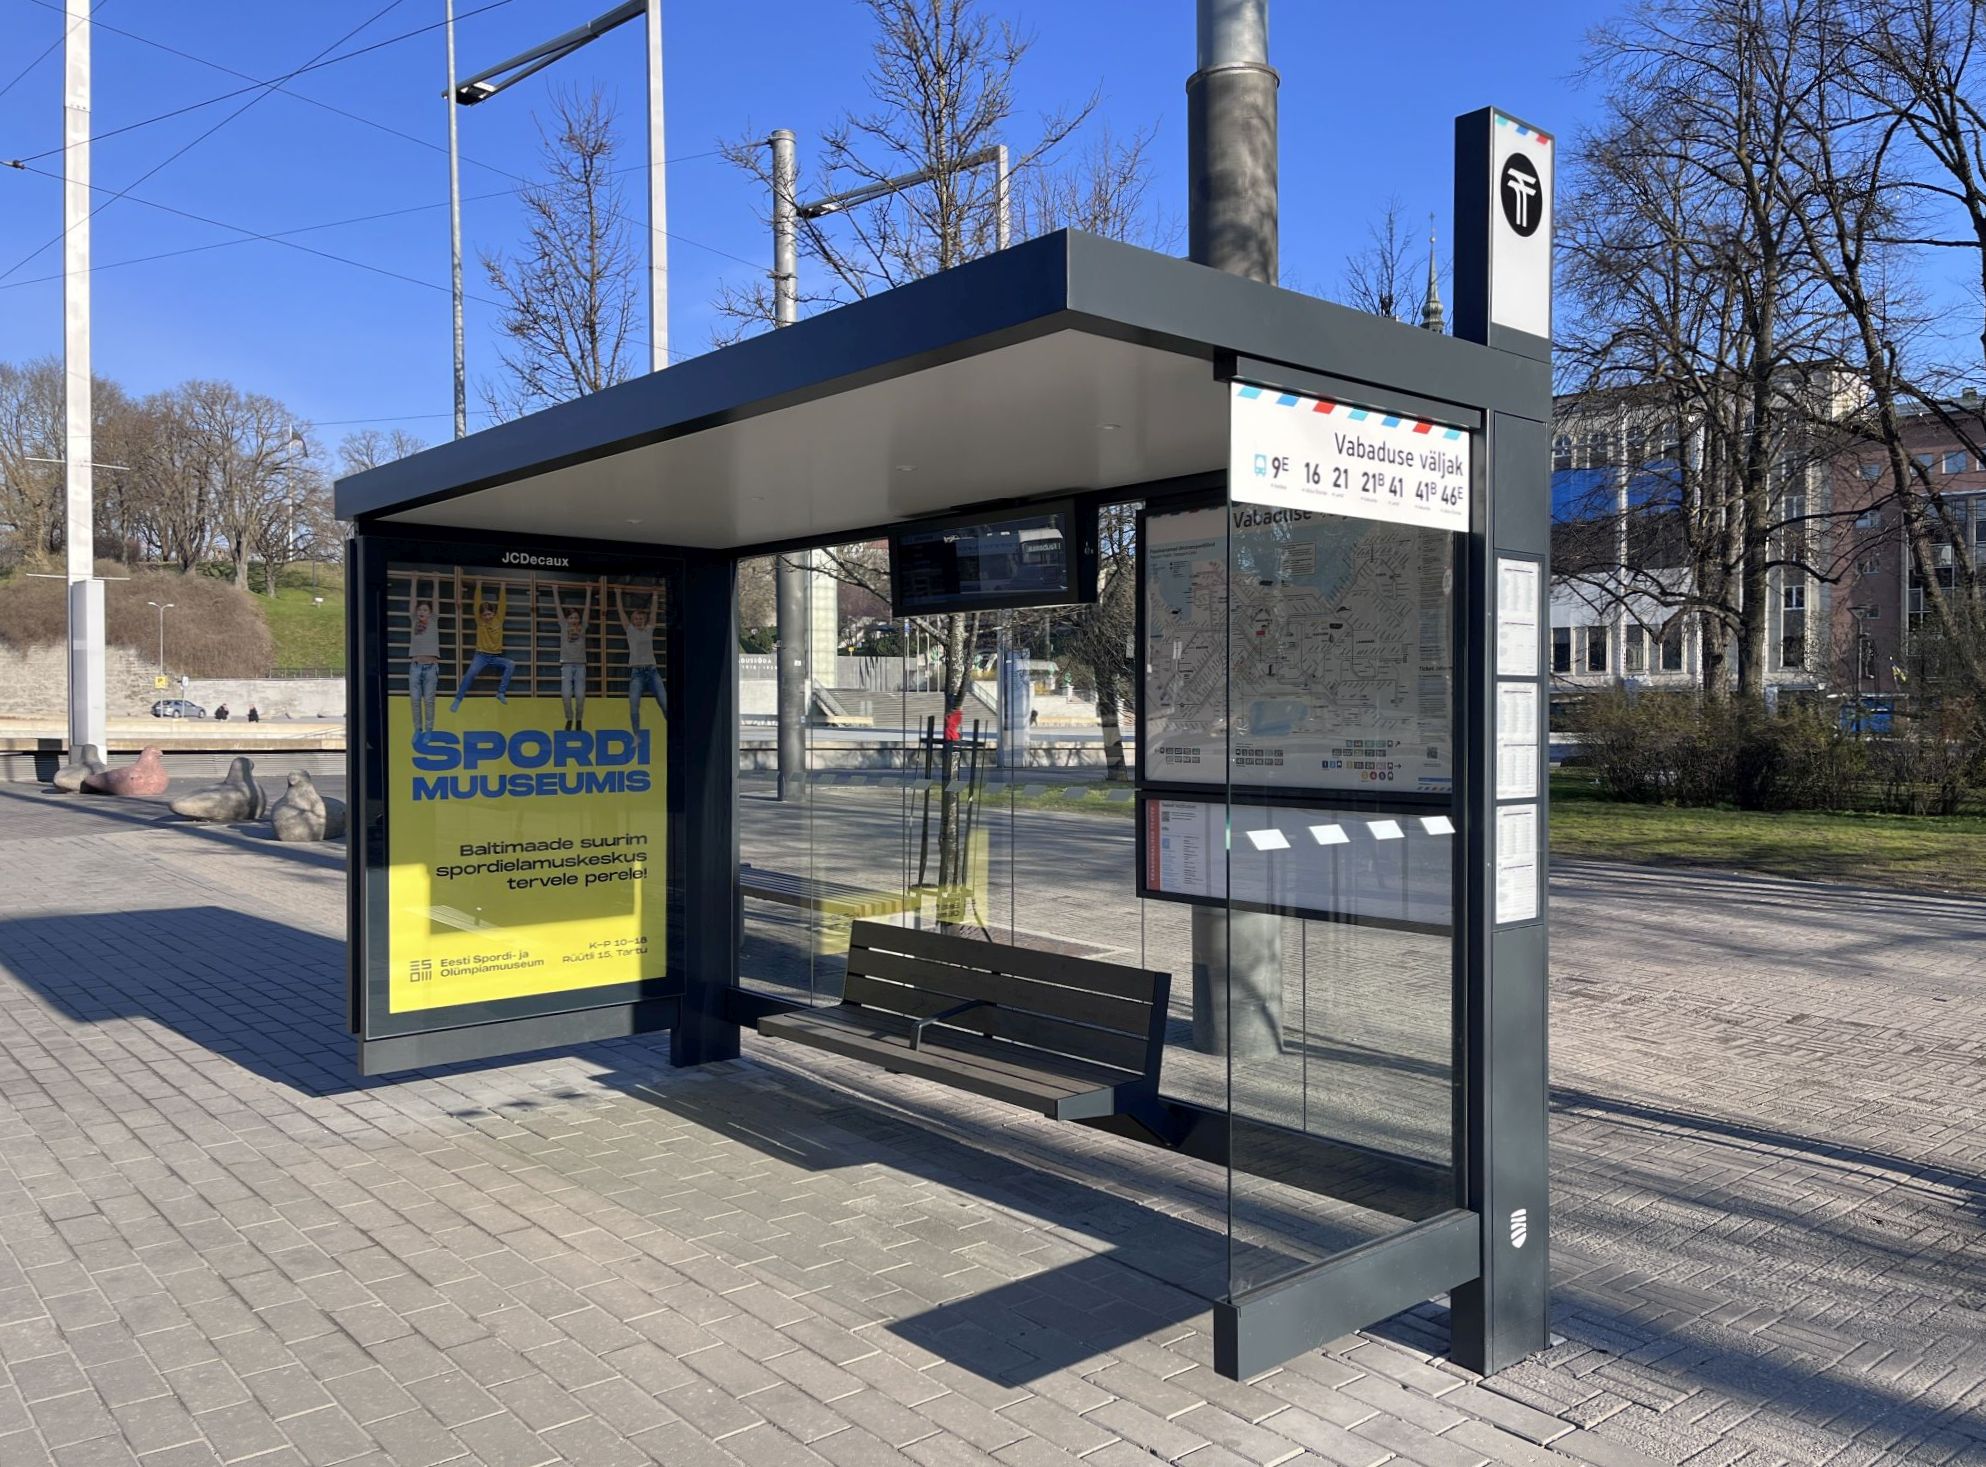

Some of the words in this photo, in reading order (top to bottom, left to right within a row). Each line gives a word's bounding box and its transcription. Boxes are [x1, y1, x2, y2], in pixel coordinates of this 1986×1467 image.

[1334, 432, 1414, 468] Vabaduse
[1419, 449, 1464, 479] väljak
[1304, 462, 1321, 485] 16
[1332, 467, 1349, 490] 21
[1388, 476, 1403, 498] 41
[502, 552, 569, 567] JCDecaux
[411, 730, 651, 771] SPORDI
[412, 770, 651, 800] MUUSEUMIS
[460, 837, 574, 857] Baltimaade
[580, 833, 648, 848] suurim
[436, 851, 647, 880] spordielamuskeskus
[506, 871, 579, 890] tervele
[585, 867, 648, 887] perele!
[440, 956, 471, 968] Eesti
[473, 951, 517, 965] Spordi-
[518, 950, 529, 962] ja
[562, 951, 595, 964] Rüütli
[616, 946, 648, 957] Tartu
[440, 958, 544, 978] Olümpiamuuseum
